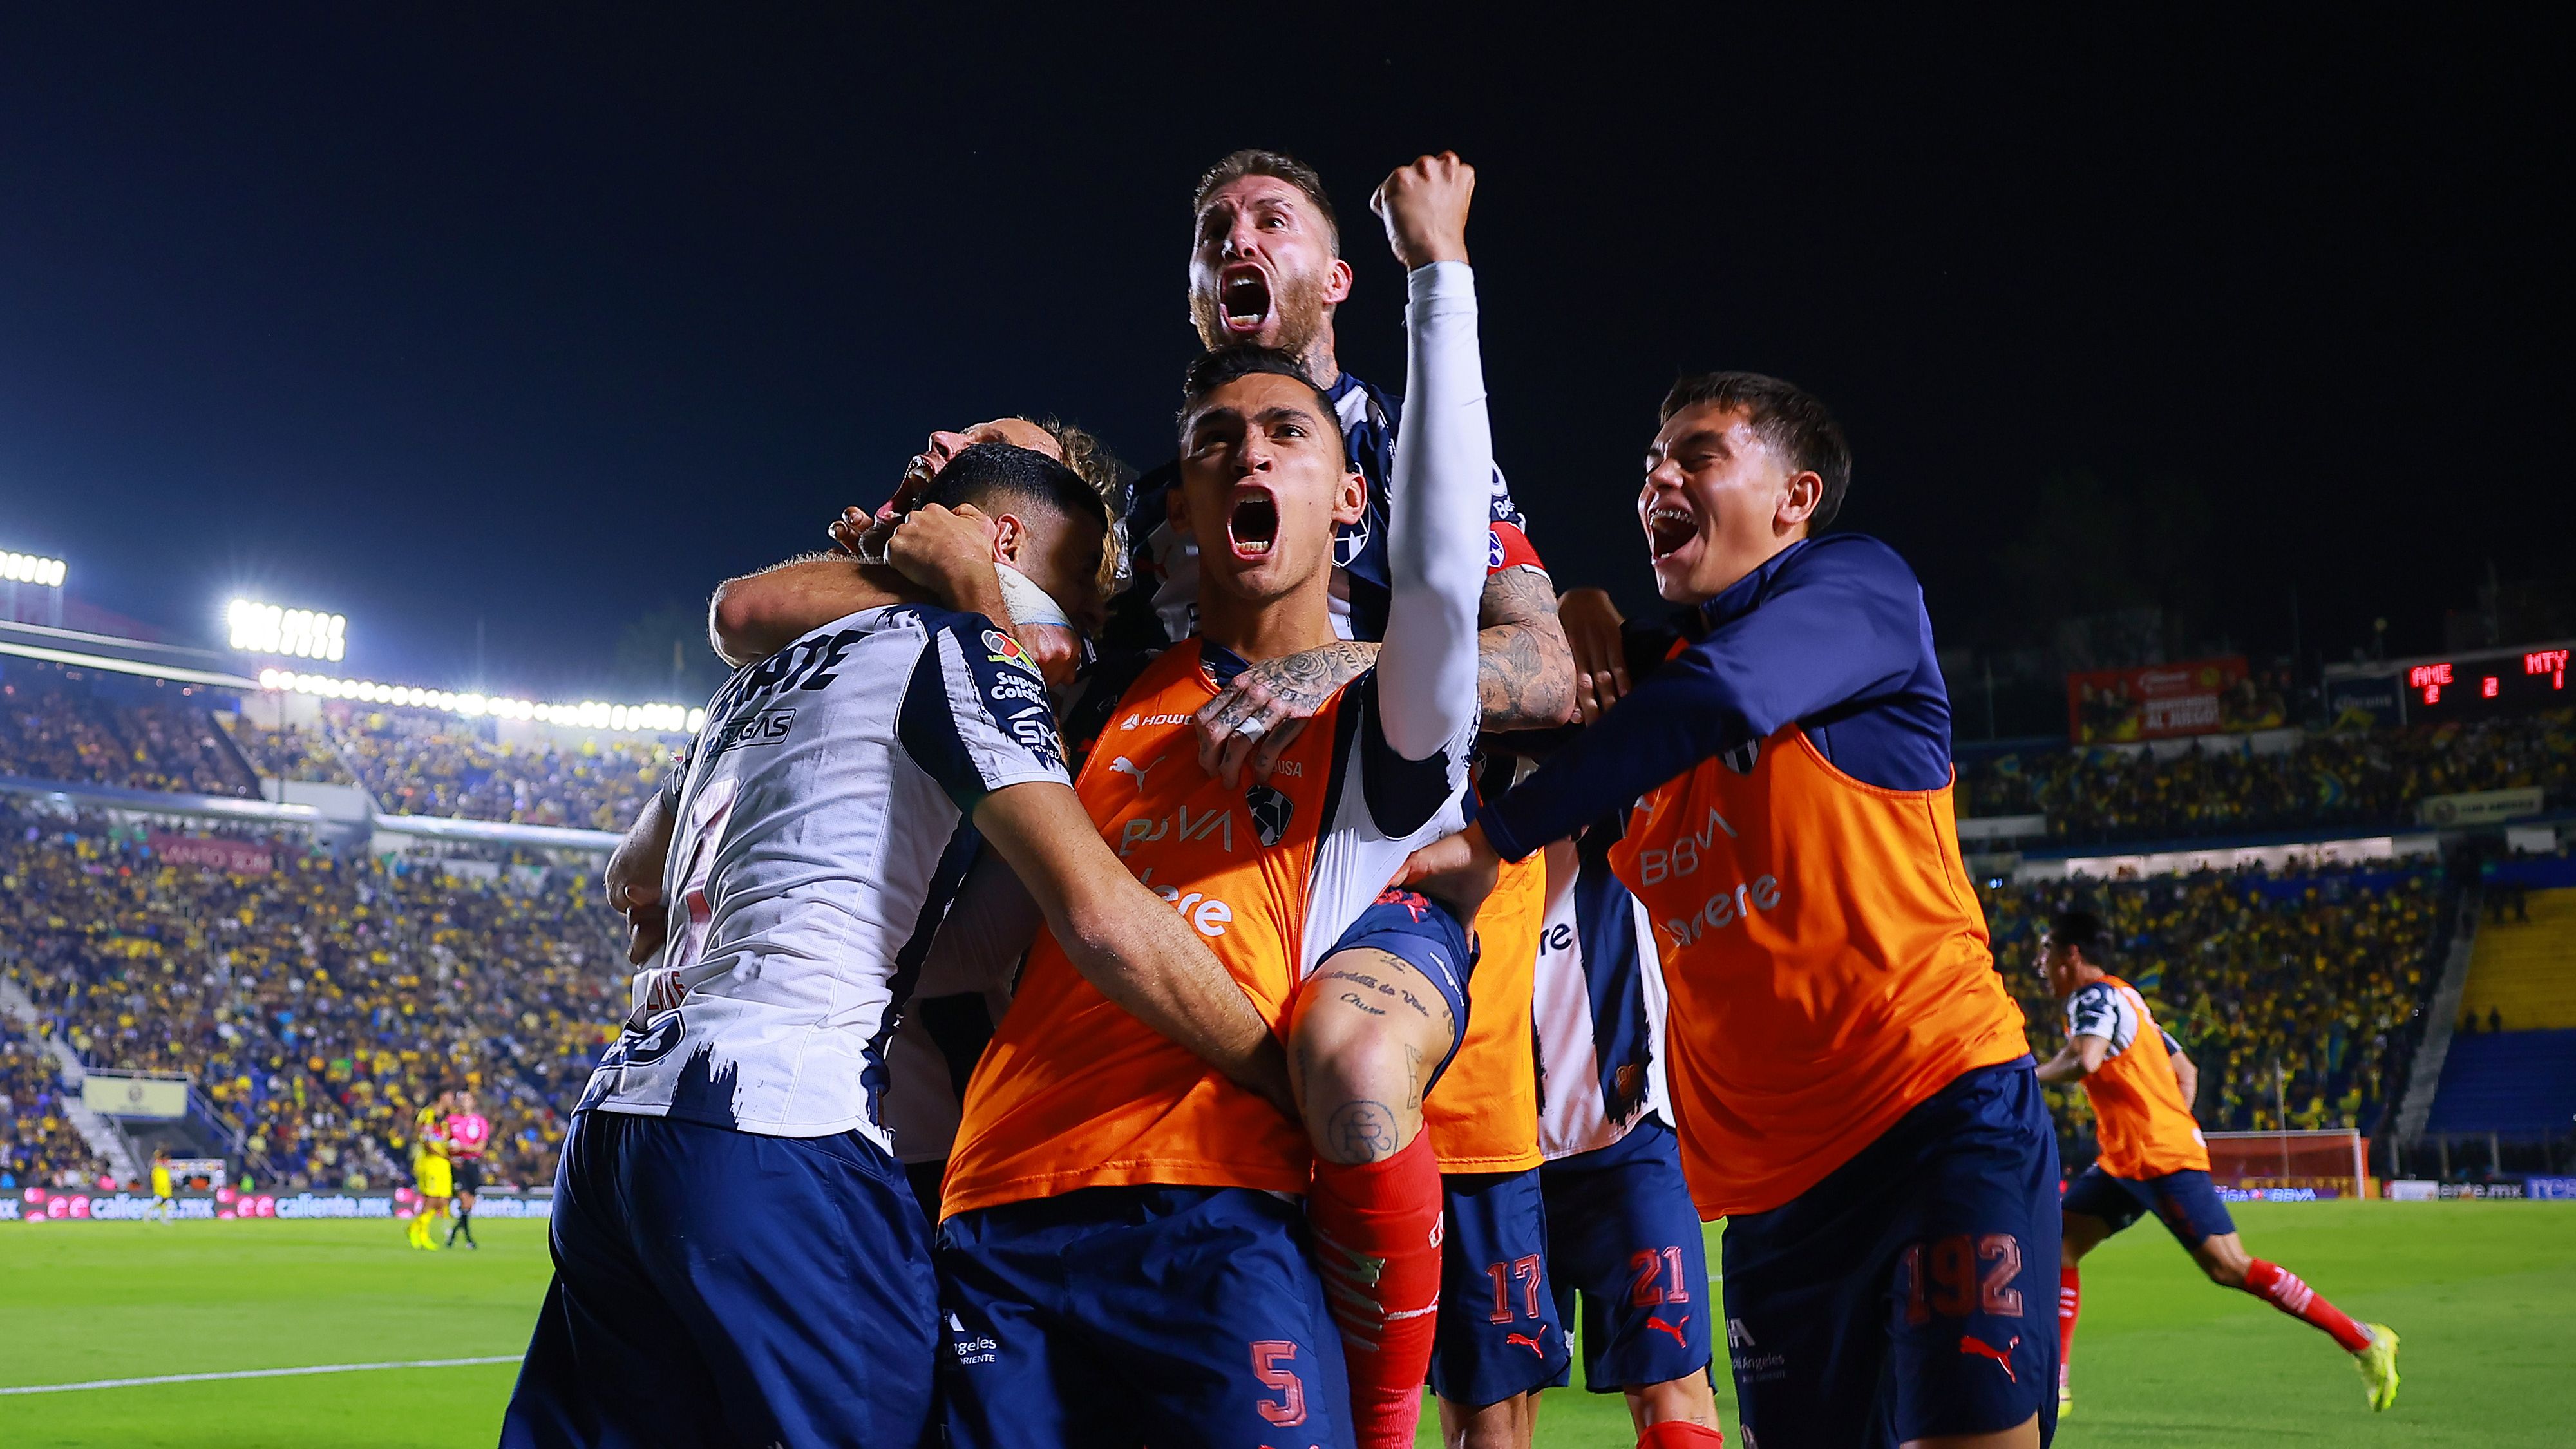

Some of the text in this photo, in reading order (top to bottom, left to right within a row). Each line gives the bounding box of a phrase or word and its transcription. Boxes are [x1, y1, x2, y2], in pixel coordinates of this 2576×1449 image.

[996, 672, 1042, 694] Super
[2409, 663, 2454, 688] AME
[2523, 649, 2570, 675] MTY
[1485, 1253, 1542, 1325] 17
[1630, 1246, 1689, 1307] 21
[1904, 1233, 2023, 1325] 192
[1248, 1339, 1307, 1428] 5
